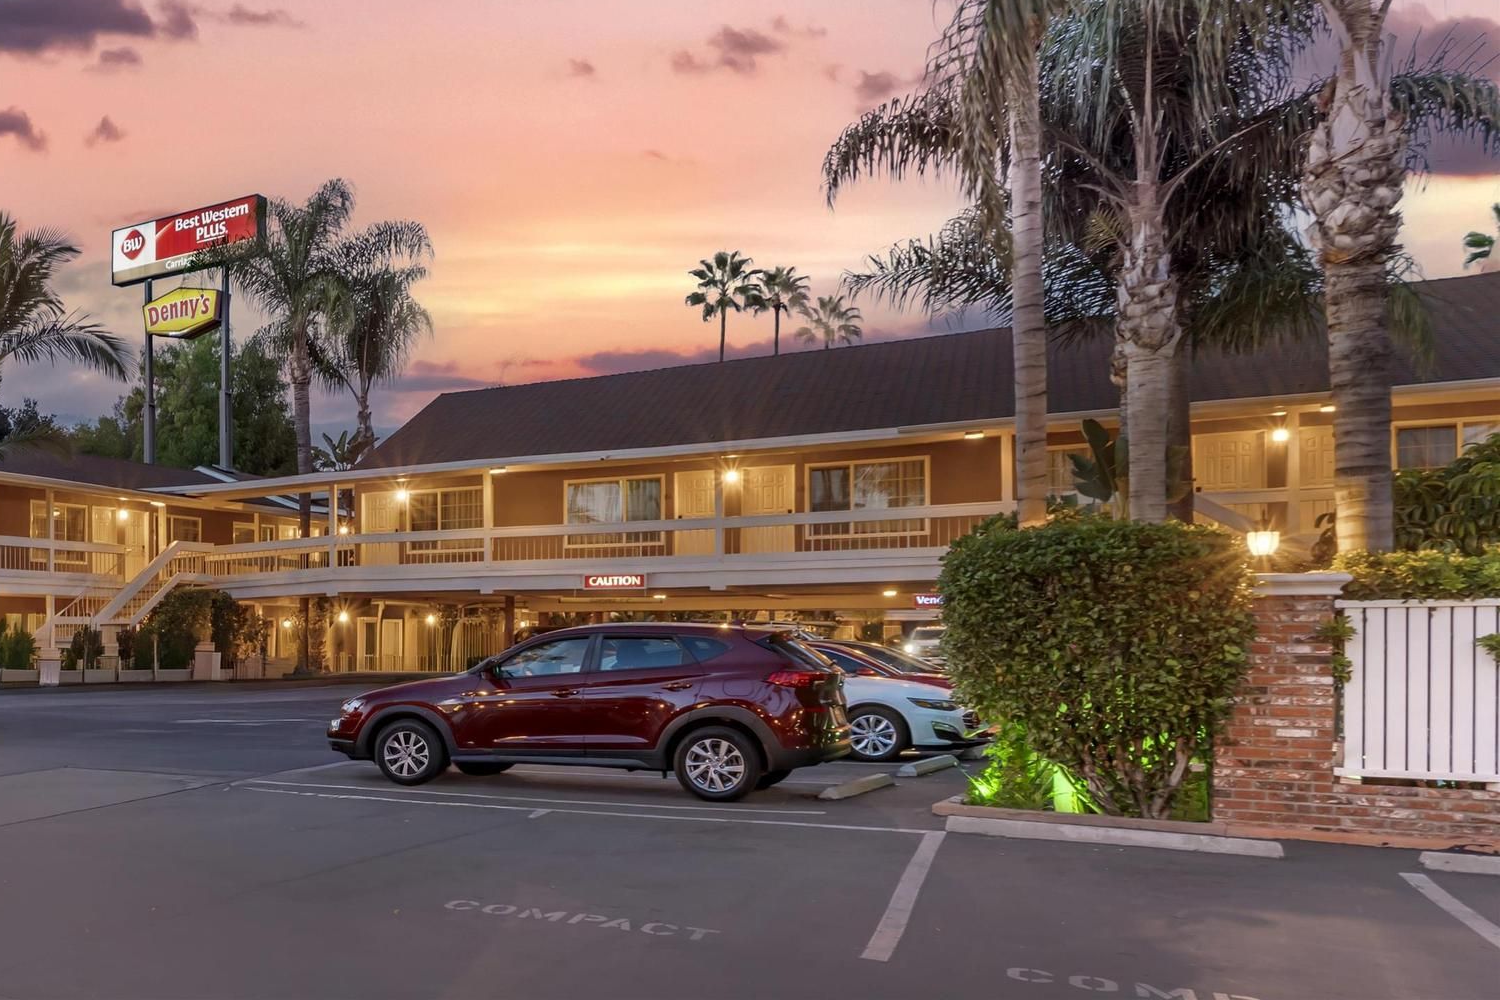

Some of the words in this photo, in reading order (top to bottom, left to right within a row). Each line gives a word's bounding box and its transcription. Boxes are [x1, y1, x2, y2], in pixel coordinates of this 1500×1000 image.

[175, 215, 200, 231] Best
[201, 203, 249, 224] Western
[123, 236, 143, 253] BW
[148, 293, 210, 327] Denny's
[588, 575, 641, 586] CAUTION
[444, 900, 721, 941] COMPACT
